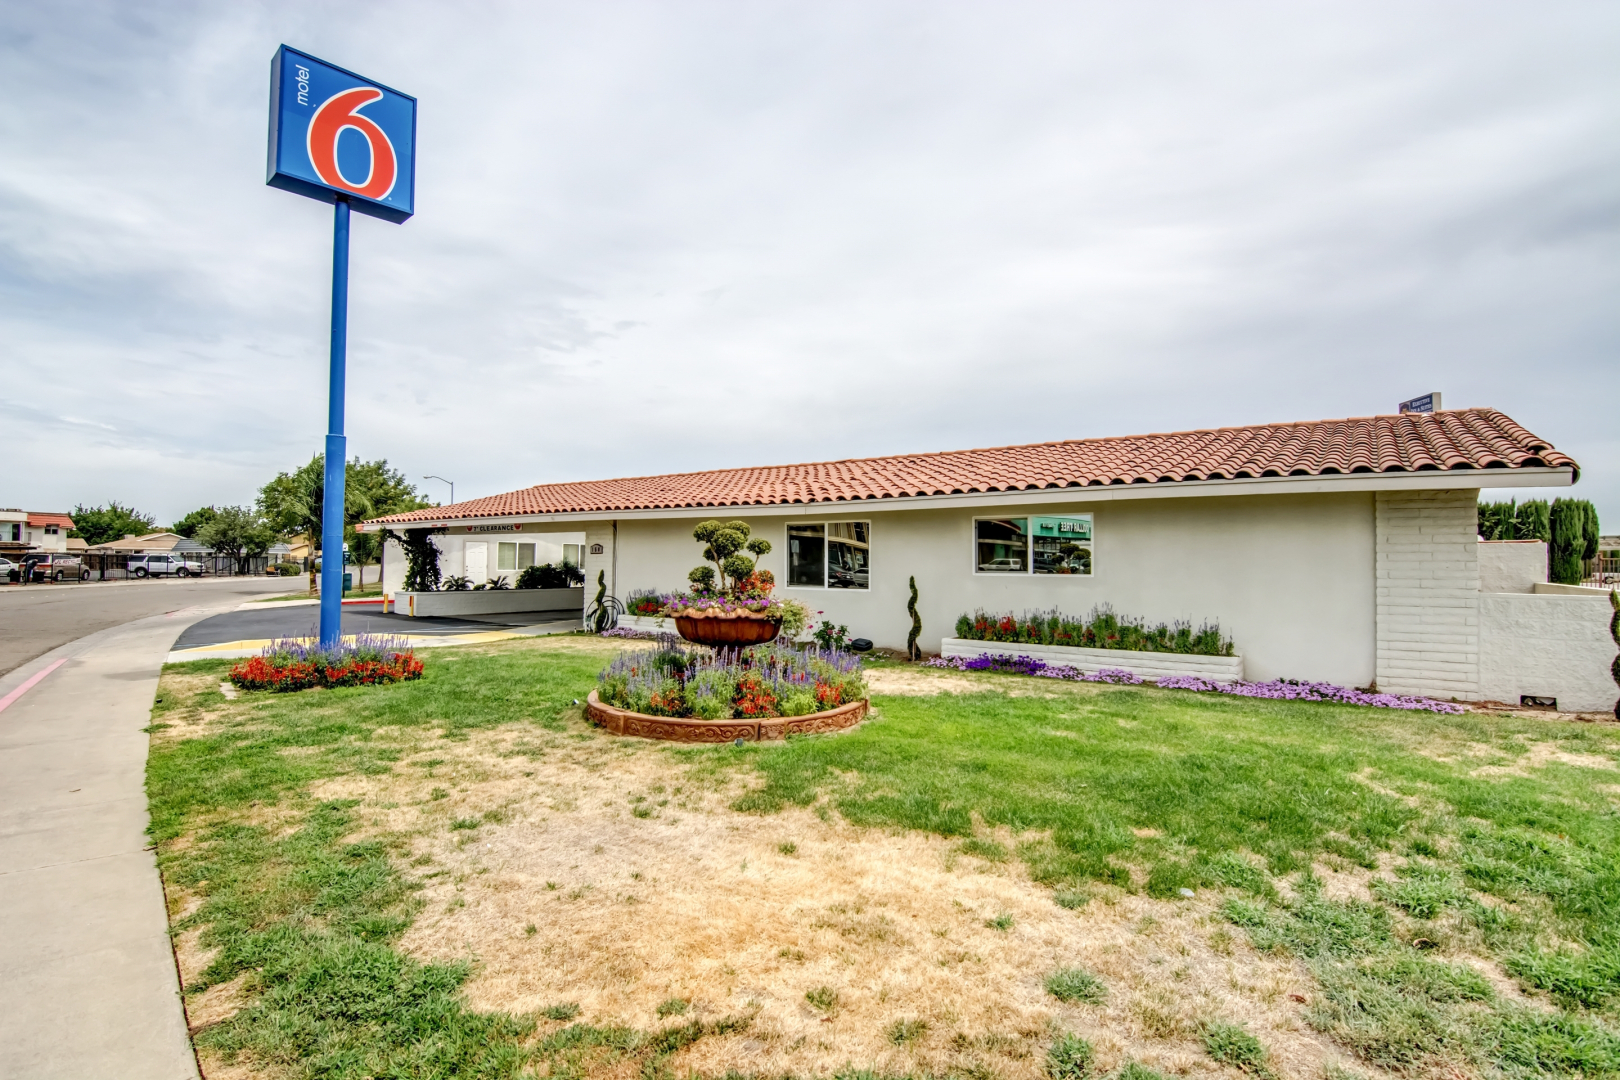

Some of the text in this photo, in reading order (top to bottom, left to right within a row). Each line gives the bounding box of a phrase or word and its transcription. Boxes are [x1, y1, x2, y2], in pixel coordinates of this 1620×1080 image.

[295, 64, 310, 106] motel
[306, 86, 398, 201] 6
[479, 524, 514, 532] CLEARANCE
